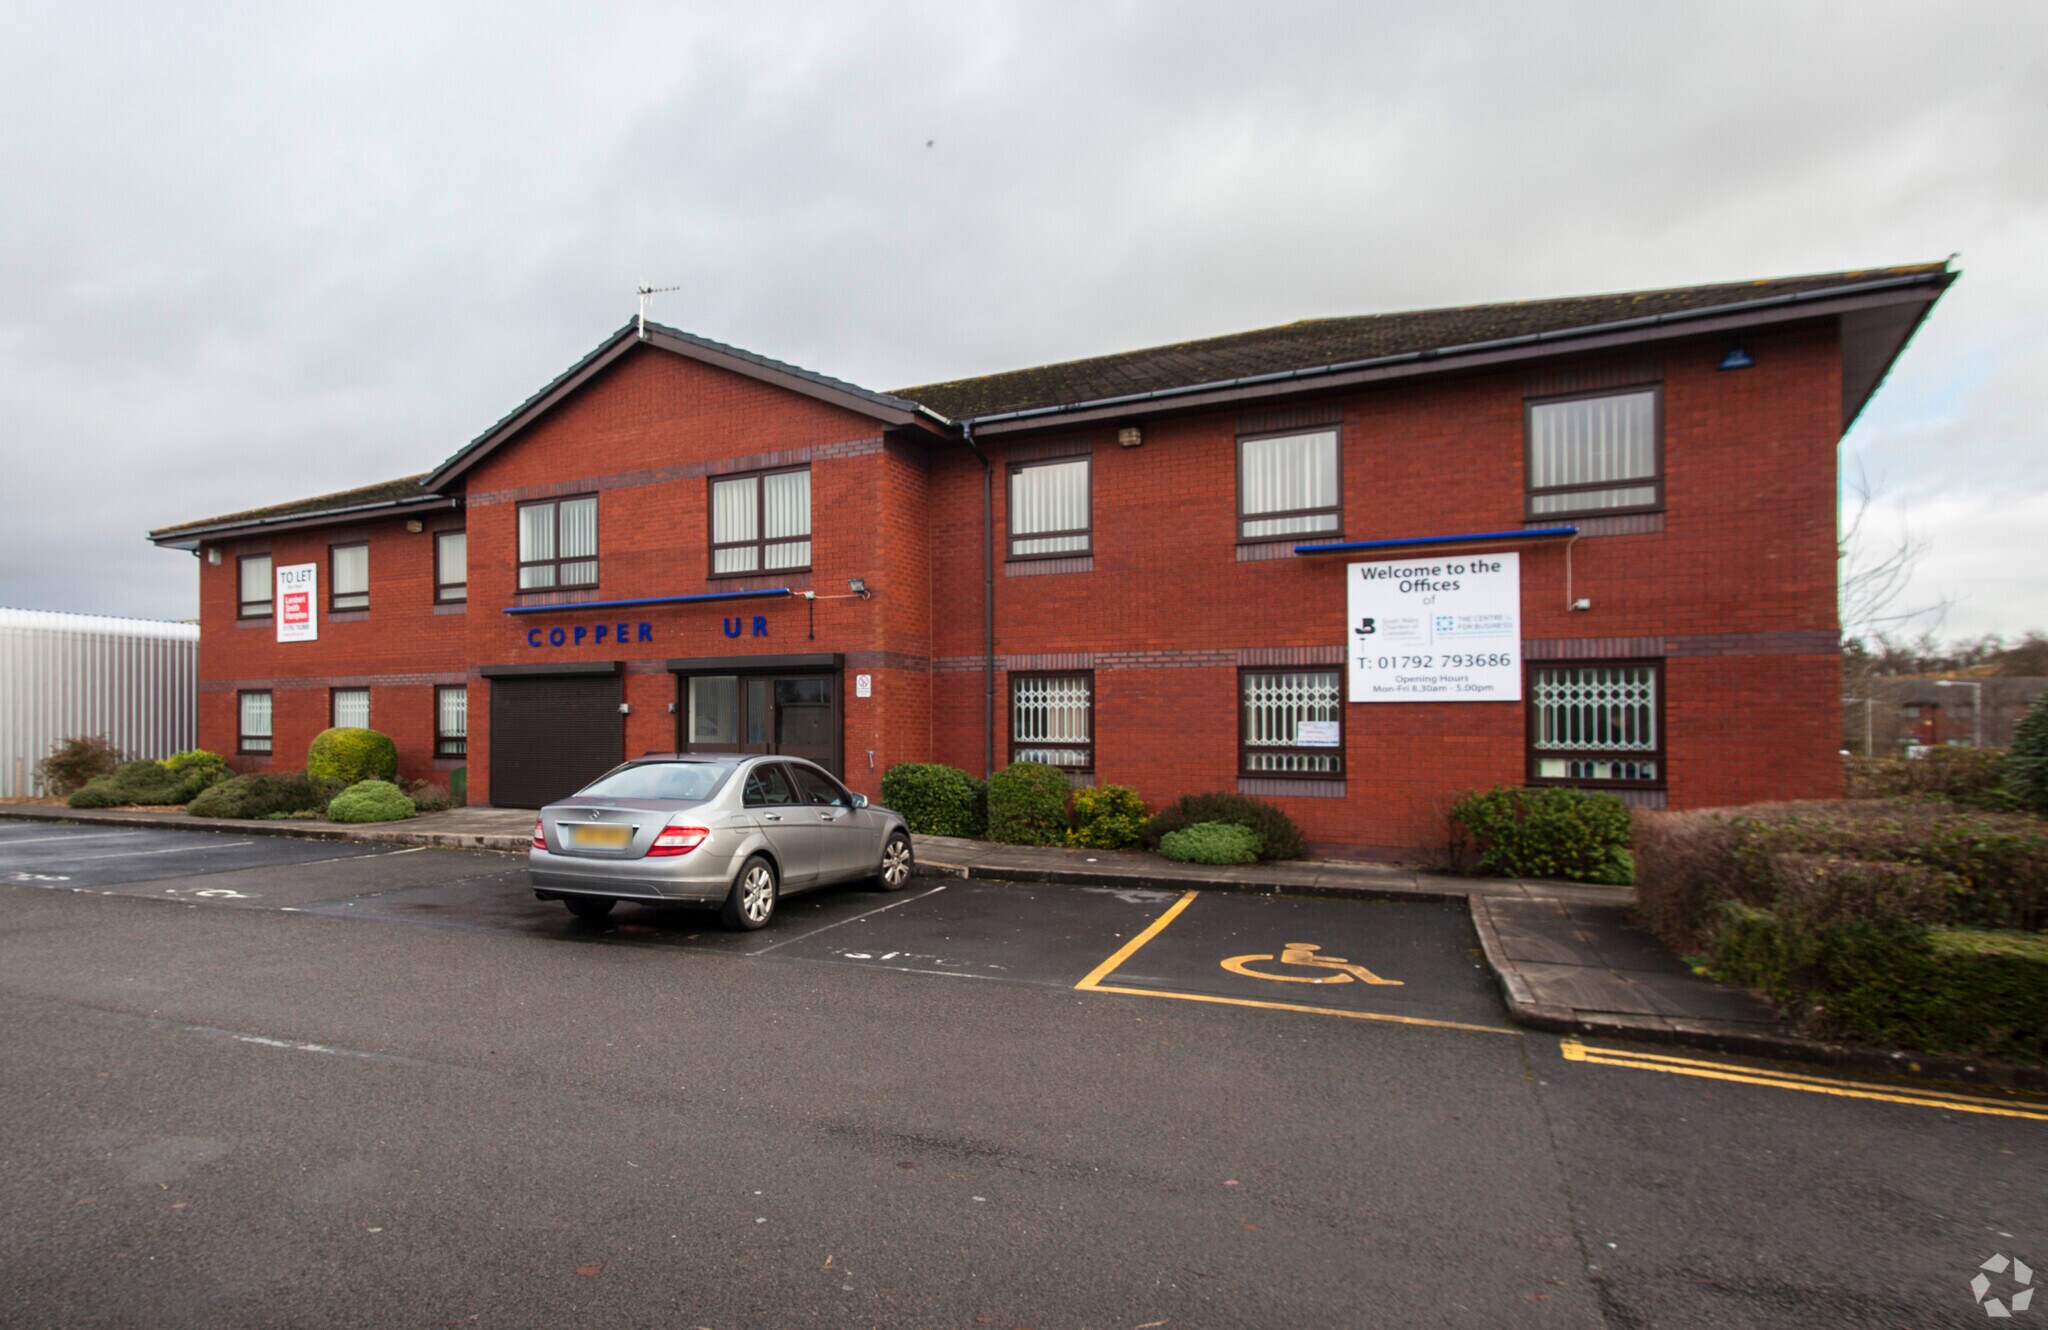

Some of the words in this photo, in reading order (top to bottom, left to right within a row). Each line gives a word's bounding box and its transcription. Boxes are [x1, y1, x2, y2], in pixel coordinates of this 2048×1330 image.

[281, 571, 293, 584] TO
[297, 569, 312, 582] LET
[1361, 565, 1442, 580] Welcome
[1447, 564, 1465, 575] to
[1470, 560, 1502, 574] the
[1399, 578, 1461, 593] Offices
[1423, 595, 1436, 606] of
[527, 621, 653, 647] COPPER
[1356, 657, 1372, 670] T:
[1378, 656, 1433, 669] 01792
[1441, 653, 1511, 668] 793686
[1395, 674, 1438, 684] Opening
[1440, 674, 1469, 682] Hours
[1373, 685, 1410, 693] Mon-Fri
[1412, 684, 1448, 692] 8.30am
